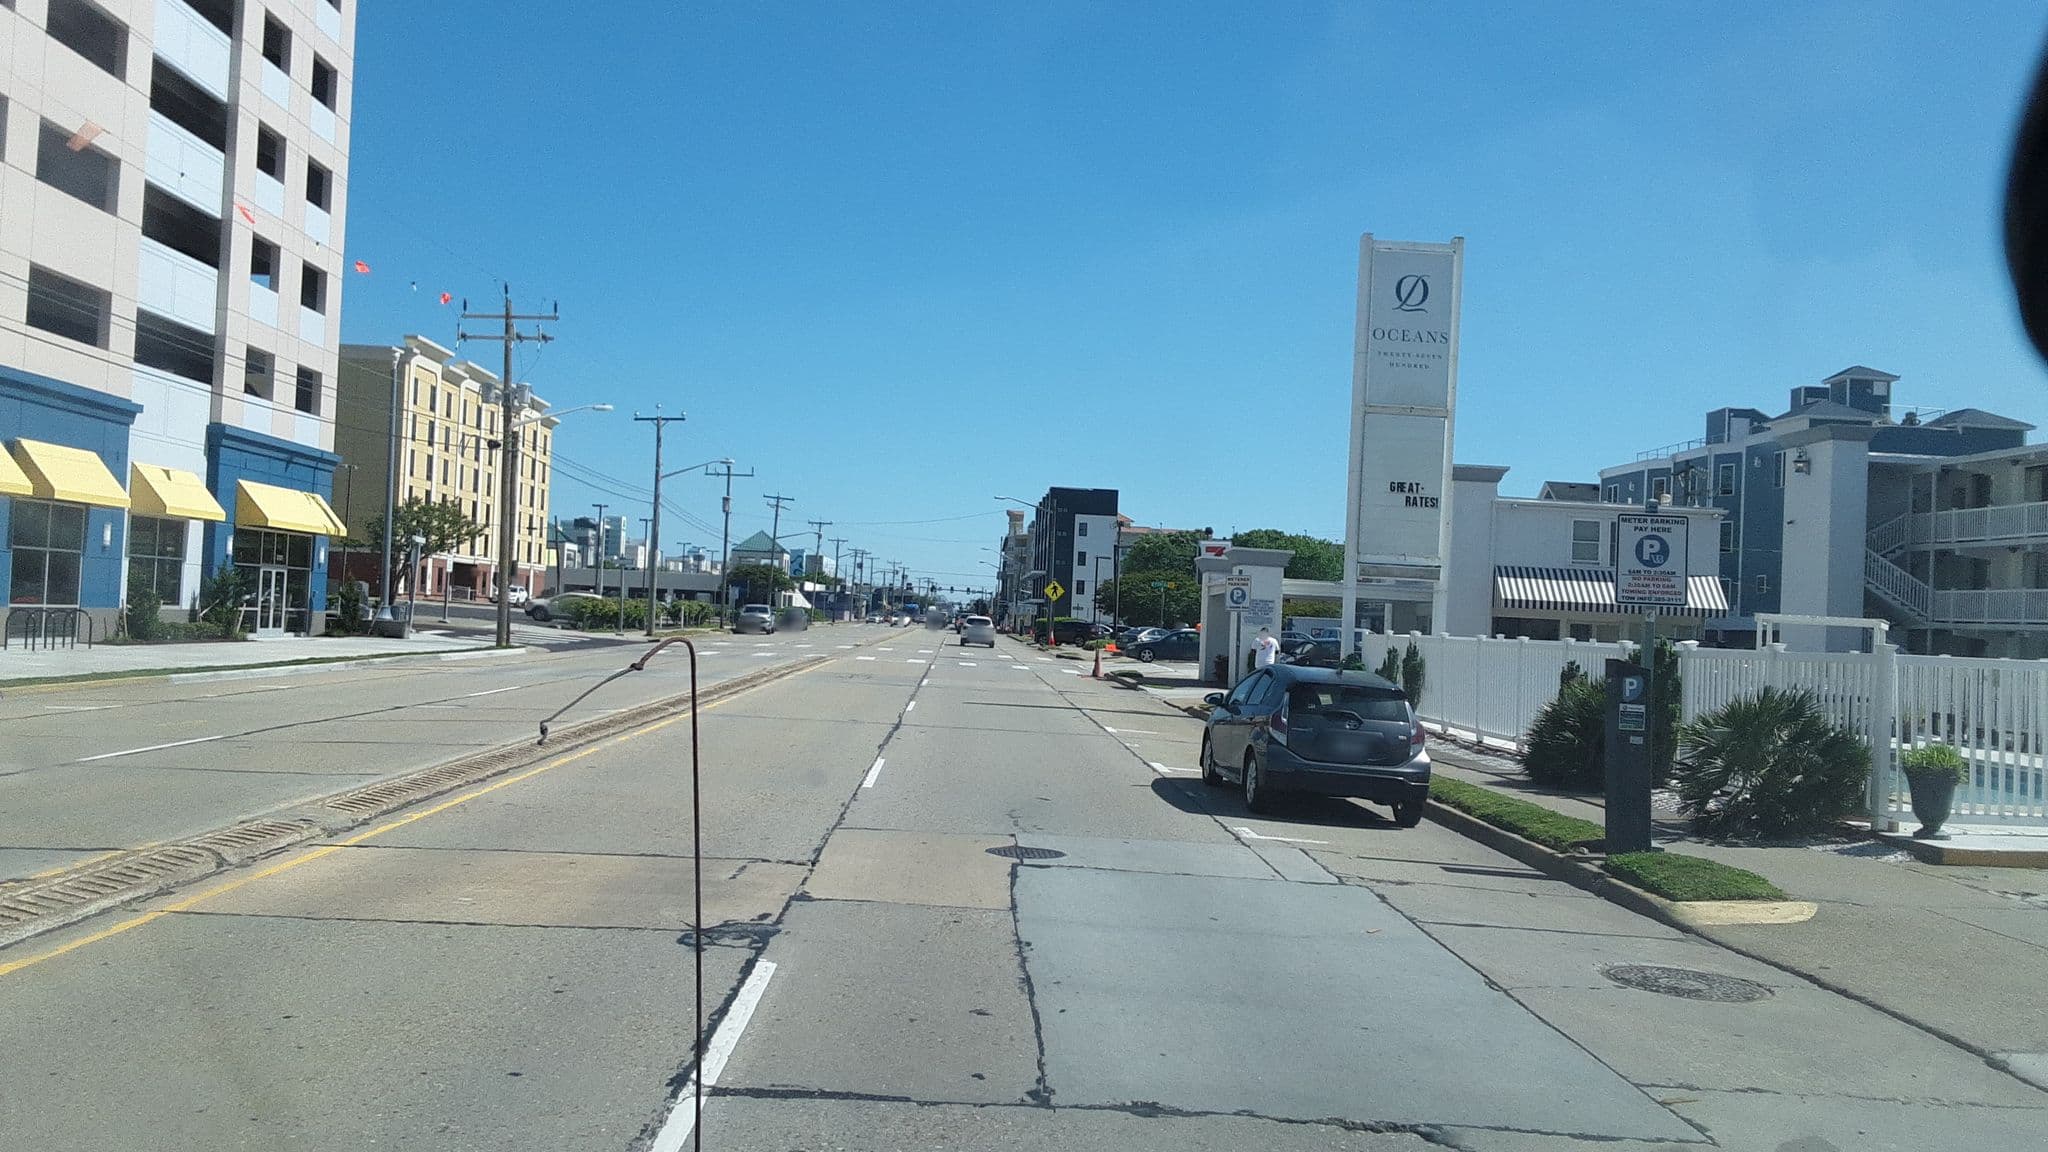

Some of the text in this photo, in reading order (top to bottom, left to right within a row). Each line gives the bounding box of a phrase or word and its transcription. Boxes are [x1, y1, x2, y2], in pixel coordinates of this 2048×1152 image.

[1372, 327, 1449, 344] OCEANS
[1404, 495, 1439, 508] RATES!
[1650, 518, 1685, 526] PARKING
[1625, 678, 1638, 697] P
